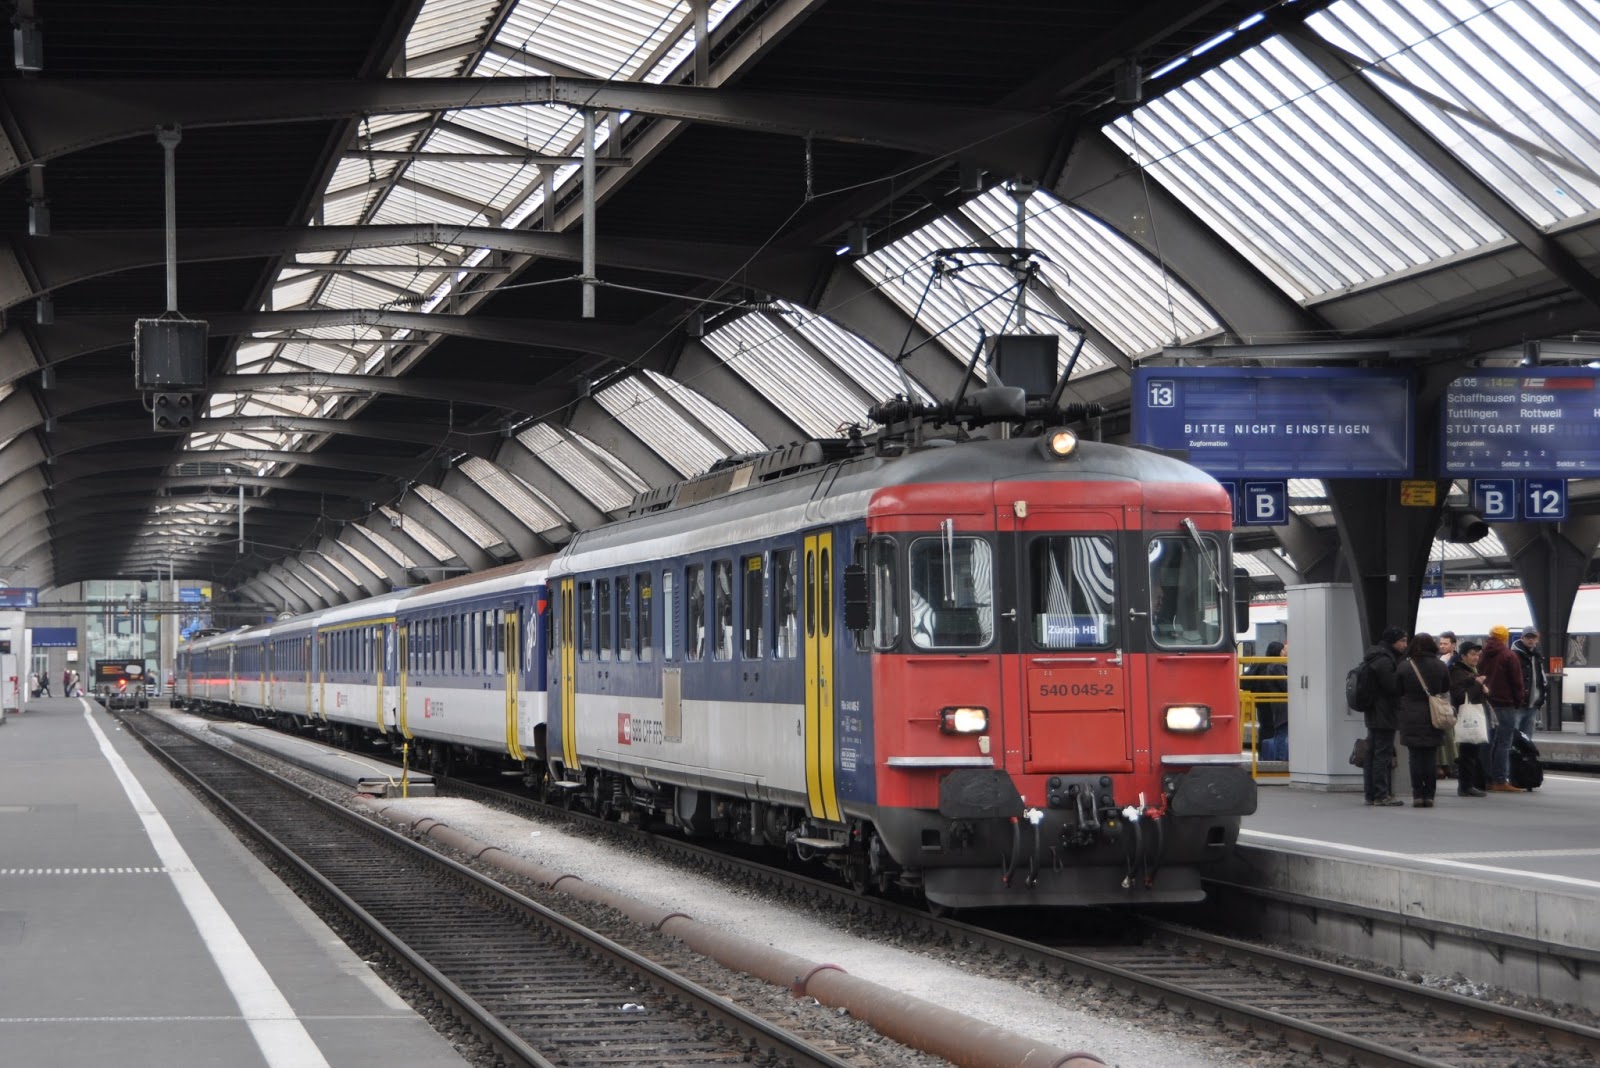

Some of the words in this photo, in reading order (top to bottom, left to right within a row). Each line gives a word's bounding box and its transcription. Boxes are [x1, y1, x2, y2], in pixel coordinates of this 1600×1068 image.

[1151, 388, 1172, 405] 13
[1447, 394, 1516, 403] Schaffhausen
[1520, 394, 1554, 404] Singen
[1447, 409, 1498, 419] Tuttlingen
[1520, 408, 1562, 418] Rottweil
[1184, 424, 1226, 433] BITTE
[1235, 424, 1276, 434] NICHT
[1286, 425, 1370, 434] EINSTEIGEN
[1446, 424, 1521, 434] STUTTGART
[1531, 424, 1556, 433] HBF
[1256, 494, 1275, 517] B
[1485, 491, 1504, 514] B
[1530, 490, 1559, 513] 12
[764, 550, 769, 578] 2
[1048, 625, 1079, 634] Zürich
[1082, 625, 1098, 634] HB
[1040, 684, 1068, 696] 540
[1071, 683, 1114, 696] 045-2
